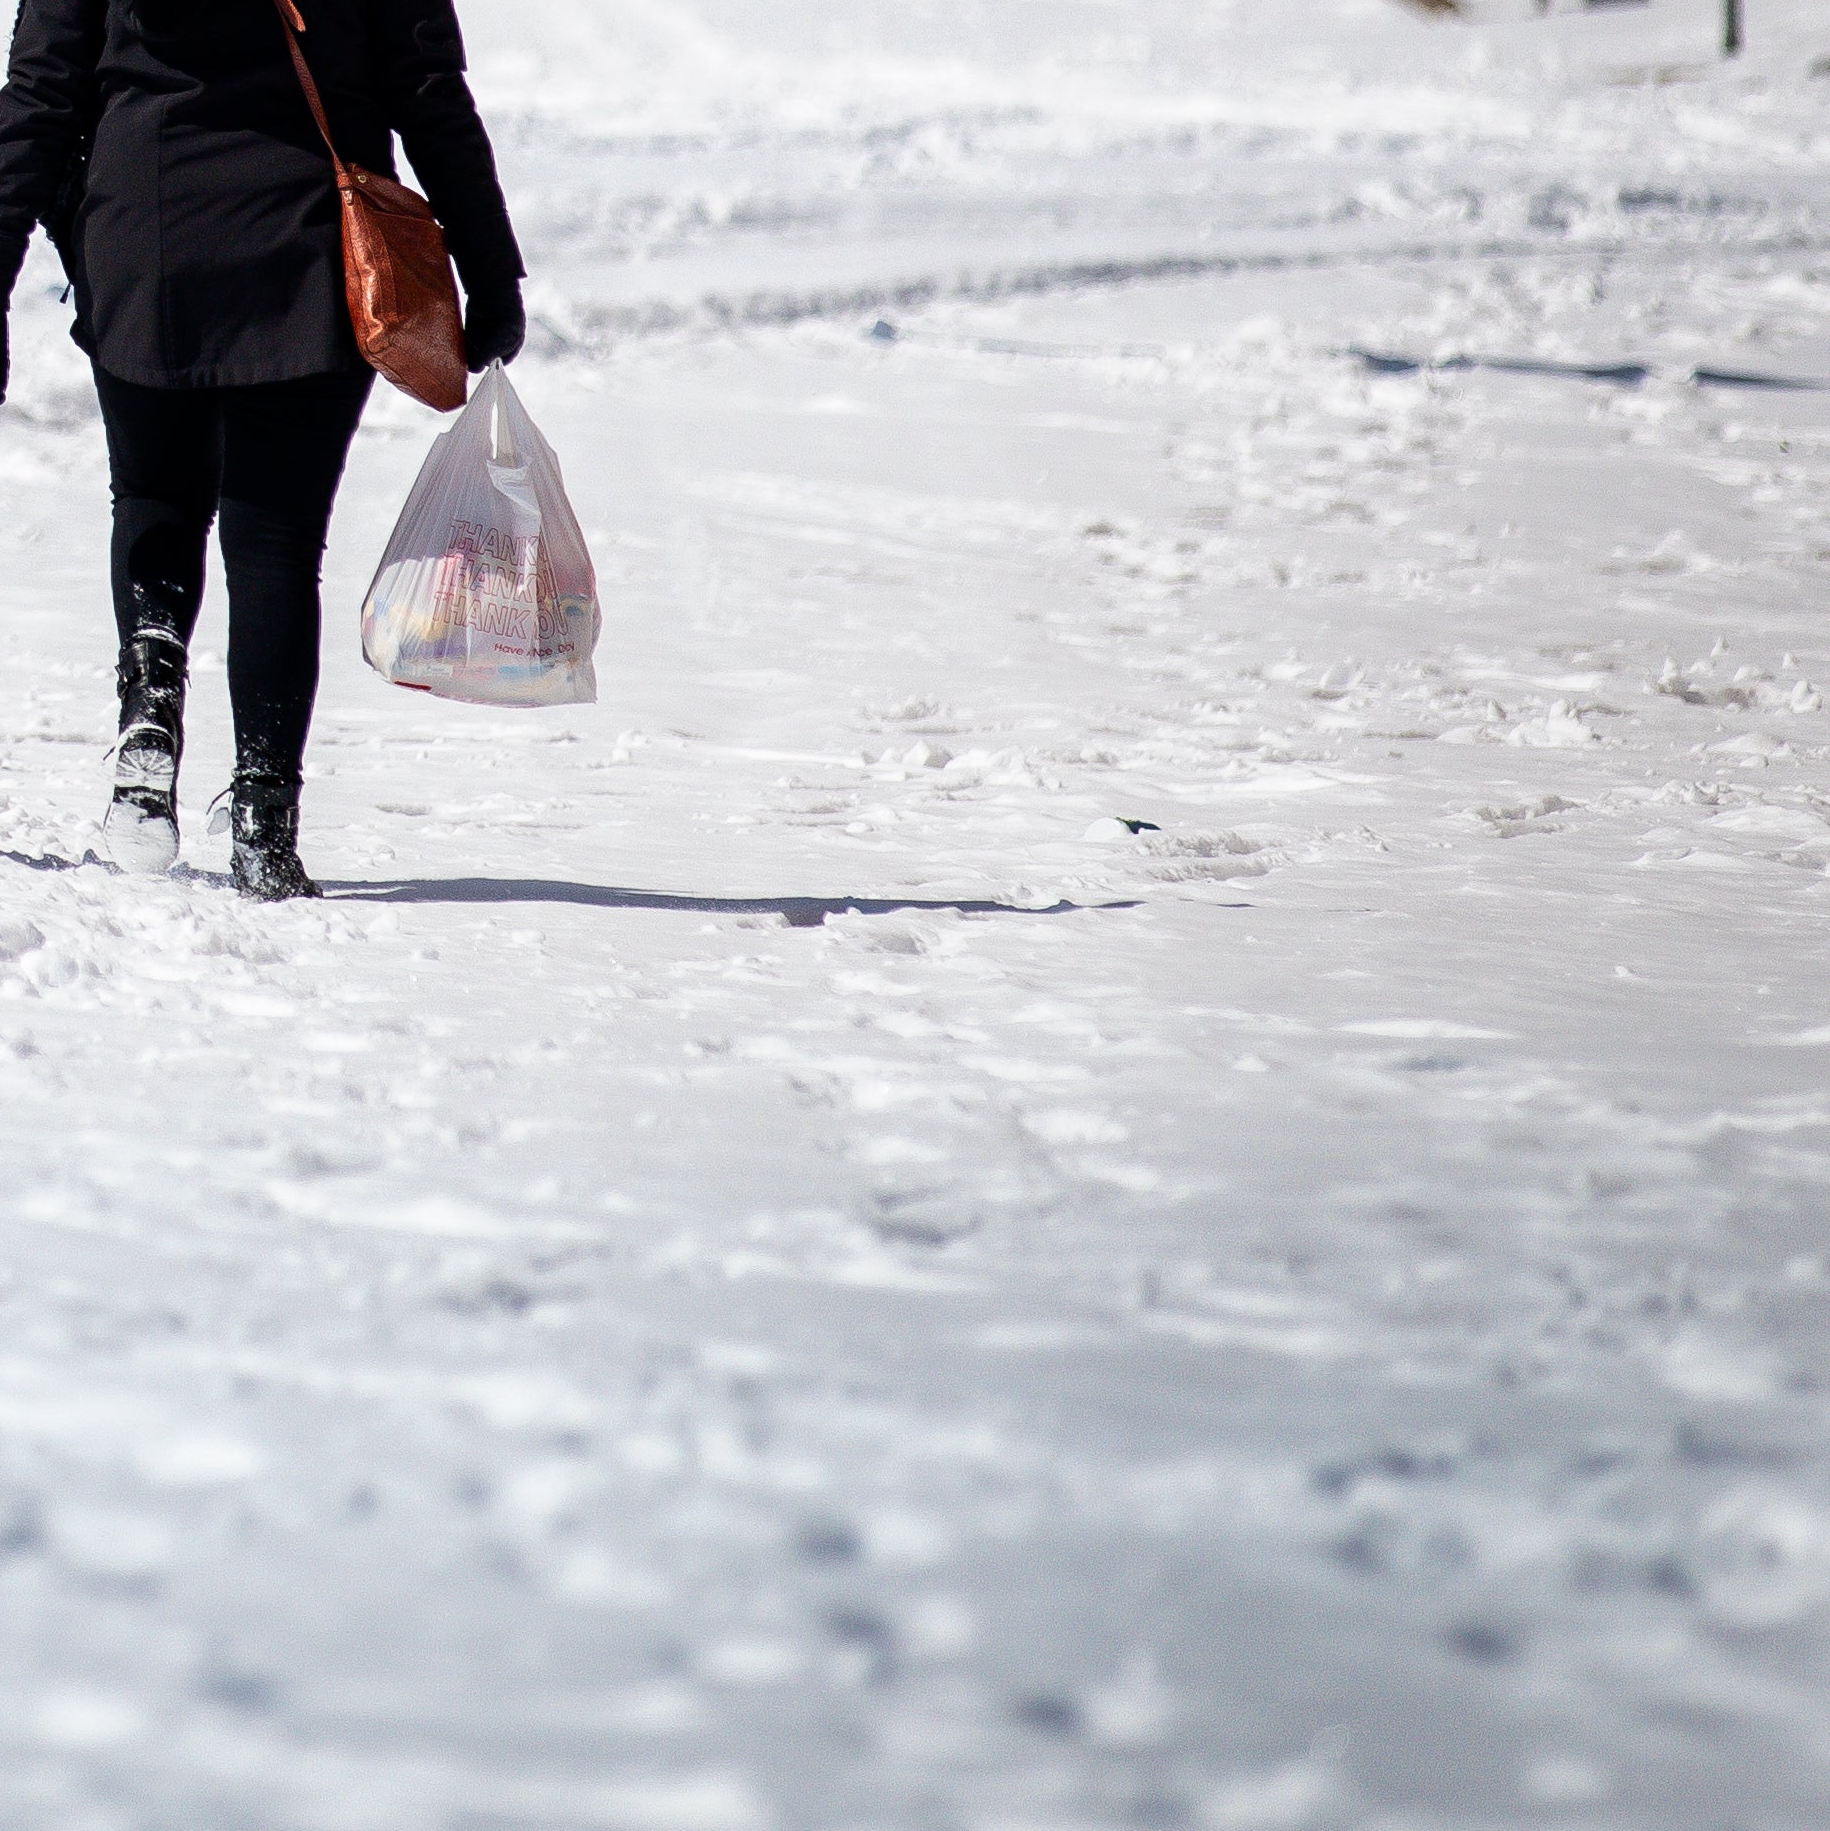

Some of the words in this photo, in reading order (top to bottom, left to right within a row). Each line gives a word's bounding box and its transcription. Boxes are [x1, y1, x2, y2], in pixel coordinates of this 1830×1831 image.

[448, 519, 540, 568] THANK
[441, 555, 537, 603] THANK
[432, 591, 531, 639] THANK
[493, 641, 525, 656] Have
